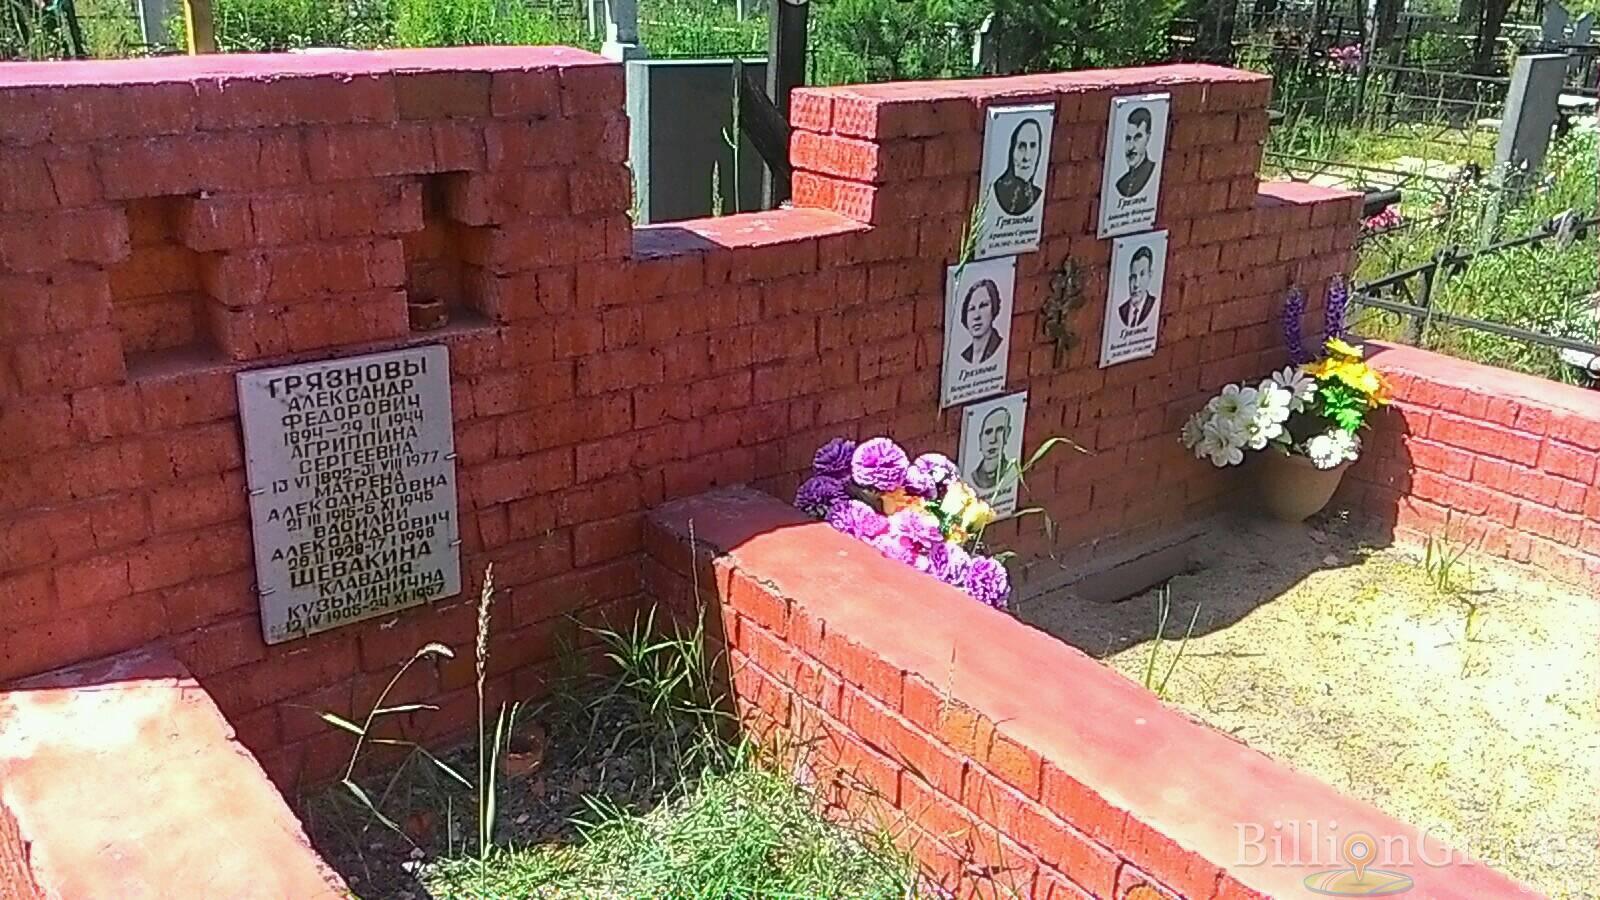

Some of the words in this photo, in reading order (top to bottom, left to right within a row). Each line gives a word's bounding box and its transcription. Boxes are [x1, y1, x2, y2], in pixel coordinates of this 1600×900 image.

[268, 356, 426, 399] ГРЯЗНОВЫ
[288, 378, 413, 413] АЛЕКСАНДР
[281, 393, 420, 430] ФЕДОРОВИЧ
[388, 409, 424, 428] 1944
[290, 425, 418, 460] АГРИППИНА
[299, 441, 414, 475] СЕРГЕЕВНА
[406, 449, 440, 468] 1977
[267, 473, 448, 523] АЛЕКСАНДРОВНА
[314, 470, 405, 499] МАТРЕНА
[380, 497, 396, 512] XI
[400, 489, 434, 508] 1945
[271, 509, 450, 562] АЛЕКСАНДРОВИЧ
[288, 555, 310, 571] 28
[401, 526, 435, 546] 1998
[290, 540, 432, 589] ШЕВАКИНА
[319, 561, 412, 597] КЛАВДИЯ
[288, 568, 445, 621] КУЗЬМИНИЧНА
